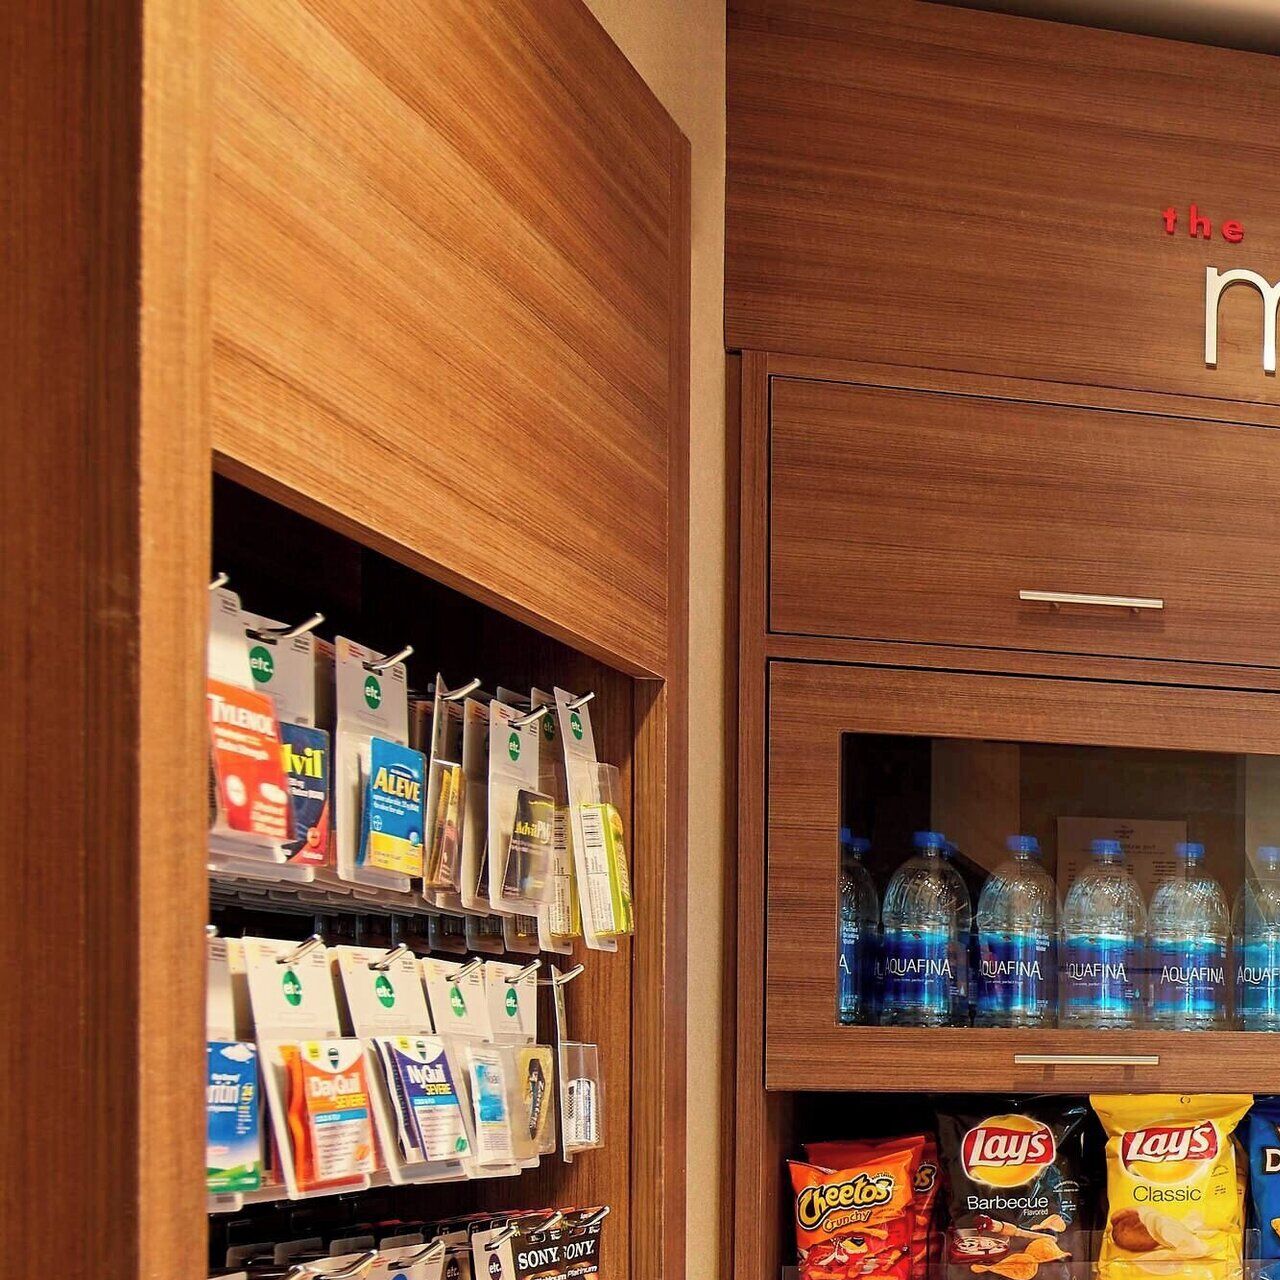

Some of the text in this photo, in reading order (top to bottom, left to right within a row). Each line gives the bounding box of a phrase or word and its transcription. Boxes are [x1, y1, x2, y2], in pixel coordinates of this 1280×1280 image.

[1163, 204, 1244, 243] the
[884, 957, 954, 979] AQUAFINA
[1161, 964, 1225, 986] AQUAFINA
[407, 1064, 443, 1088] NyQuil
[968, 1122, 1052, 1167] Lay's
[1126, 1120, 1217, 1162] Lay's
[797, 1174, 893, 1229] Cheetos
[968, 1196, 1048, 1210] Barbecue
[1133, 1184, 1202, 1203] Classic
[823, 1209, 871, 1232] Crunchy
